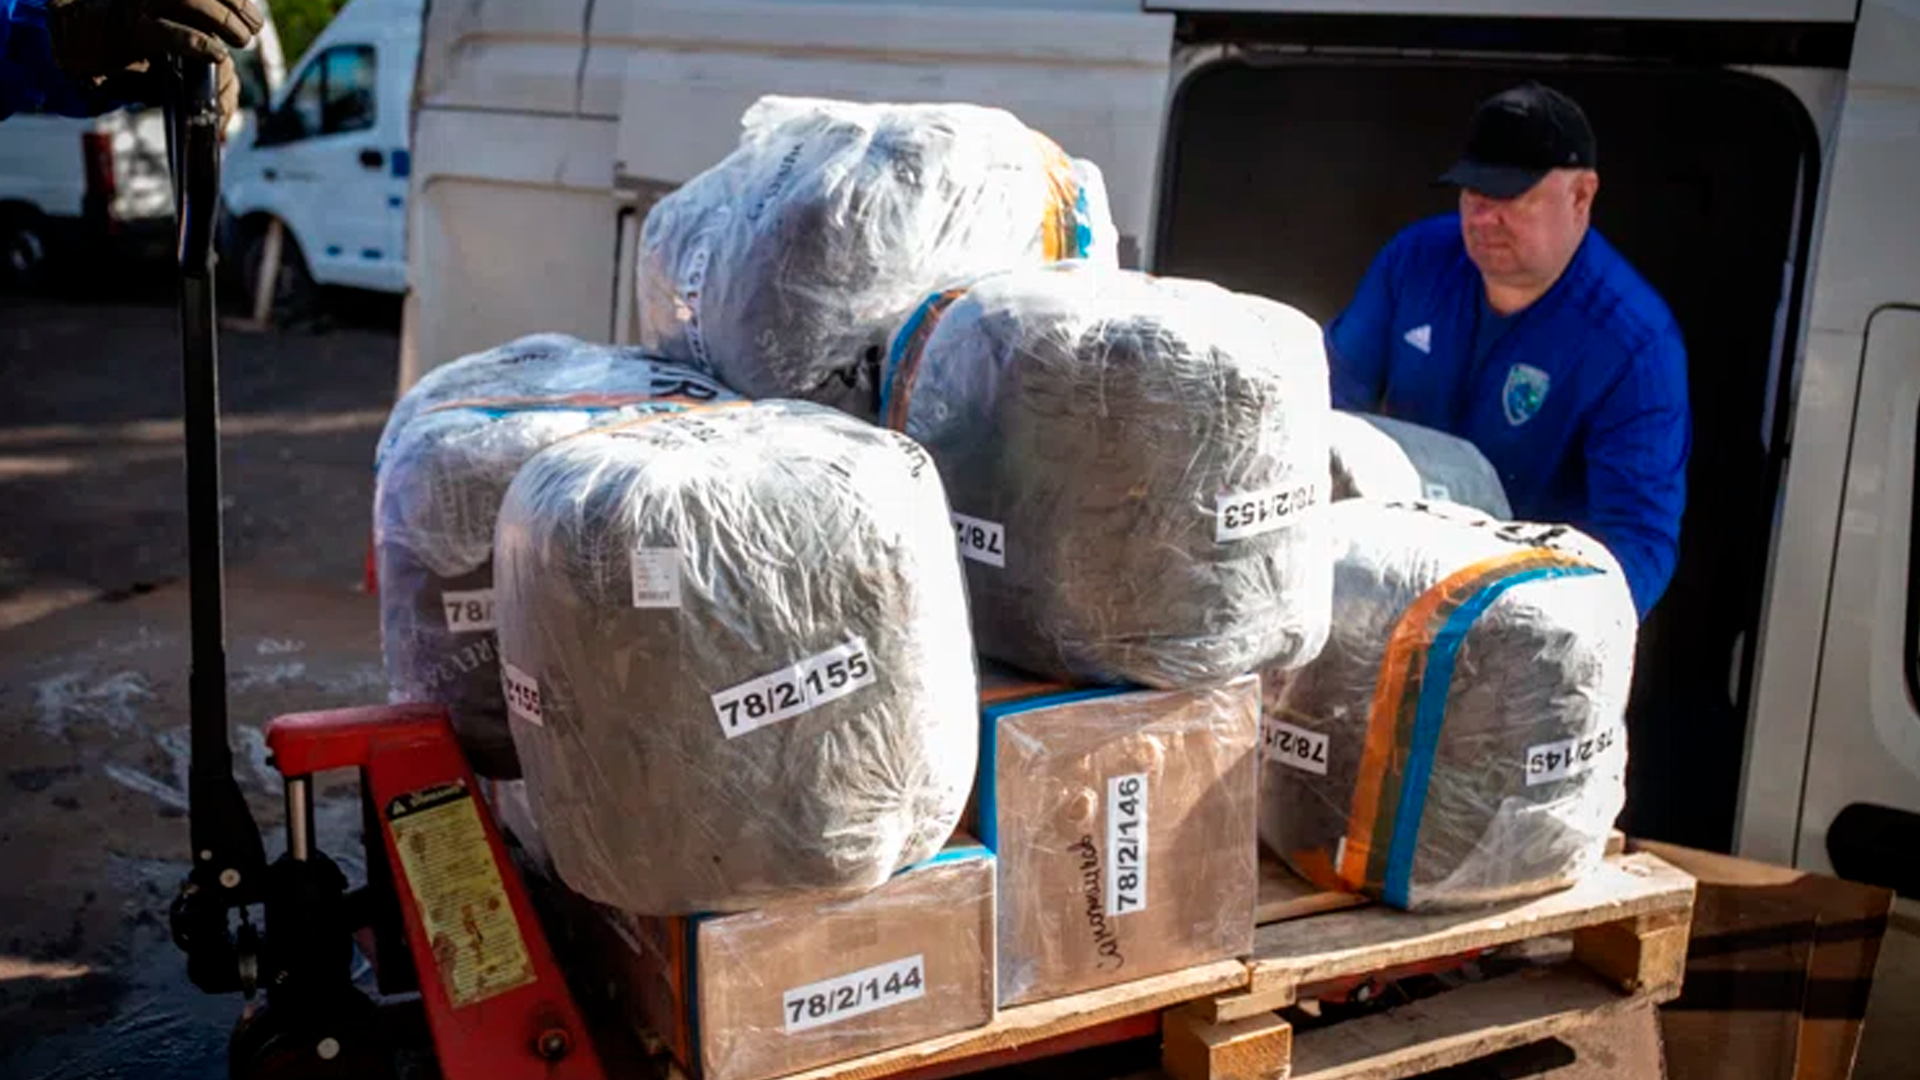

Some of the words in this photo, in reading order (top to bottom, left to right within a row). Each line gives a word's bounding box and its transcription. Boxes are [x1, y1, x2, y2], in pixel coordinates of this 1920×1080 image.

[719, 652, 869, 727] 78/2/155
[1261, 723, 1325, 763] 78/2/1
[1117, 777, 1140, 912] 78/2/146
[787, 966, 923, 1023] 78/2/144
